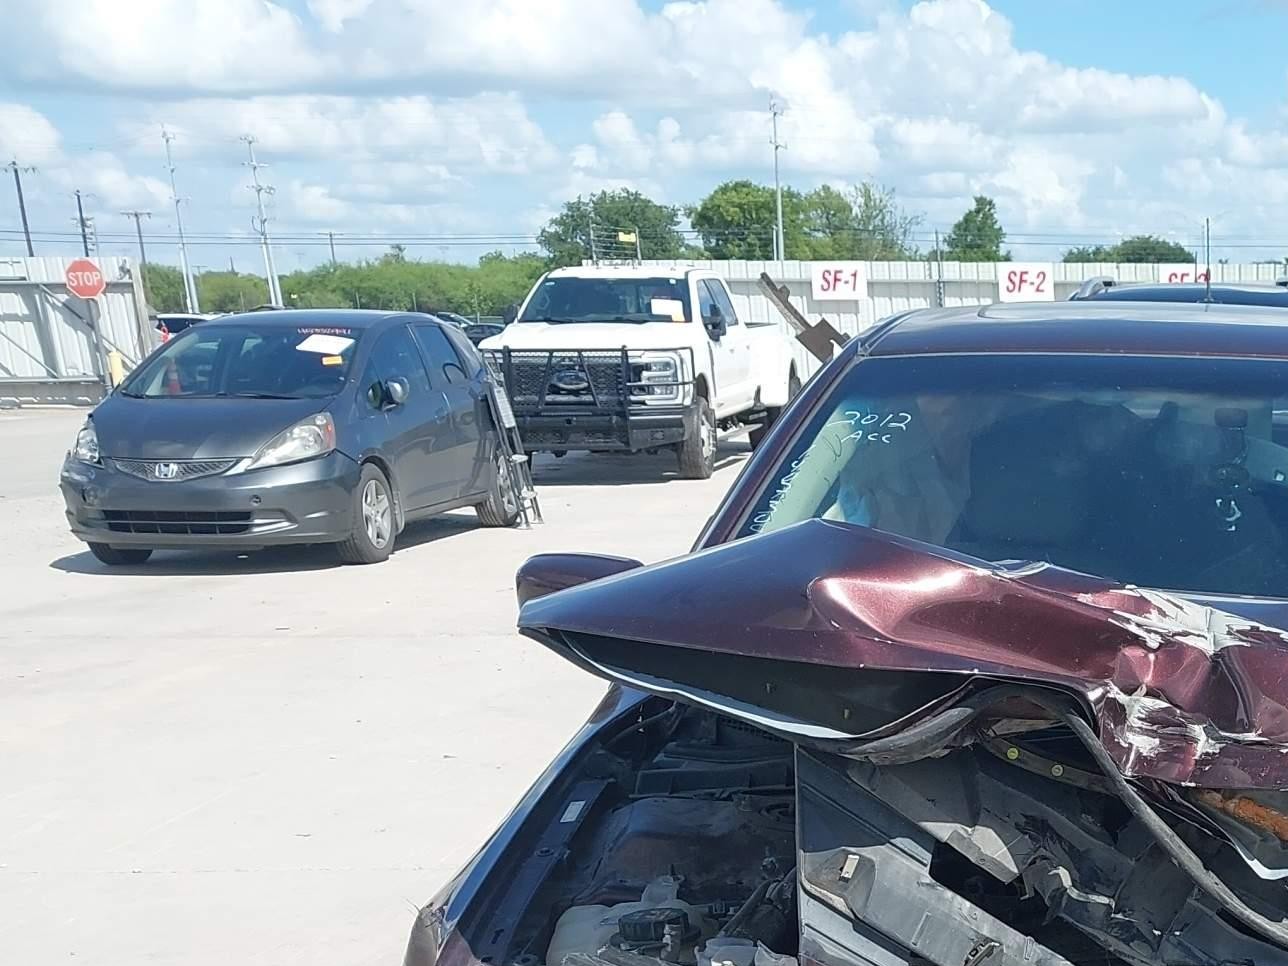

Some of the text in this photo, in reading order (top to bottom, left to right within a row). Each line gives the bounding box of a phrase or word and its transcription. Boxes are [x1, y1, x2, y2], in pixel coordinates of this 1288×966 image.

[69, 271, 101, 287] STOP
[821, 270, 858, 292] SF-1
[1006, 271, 1046, 293] SF-2
[827, 411, 912, 431] 2012
